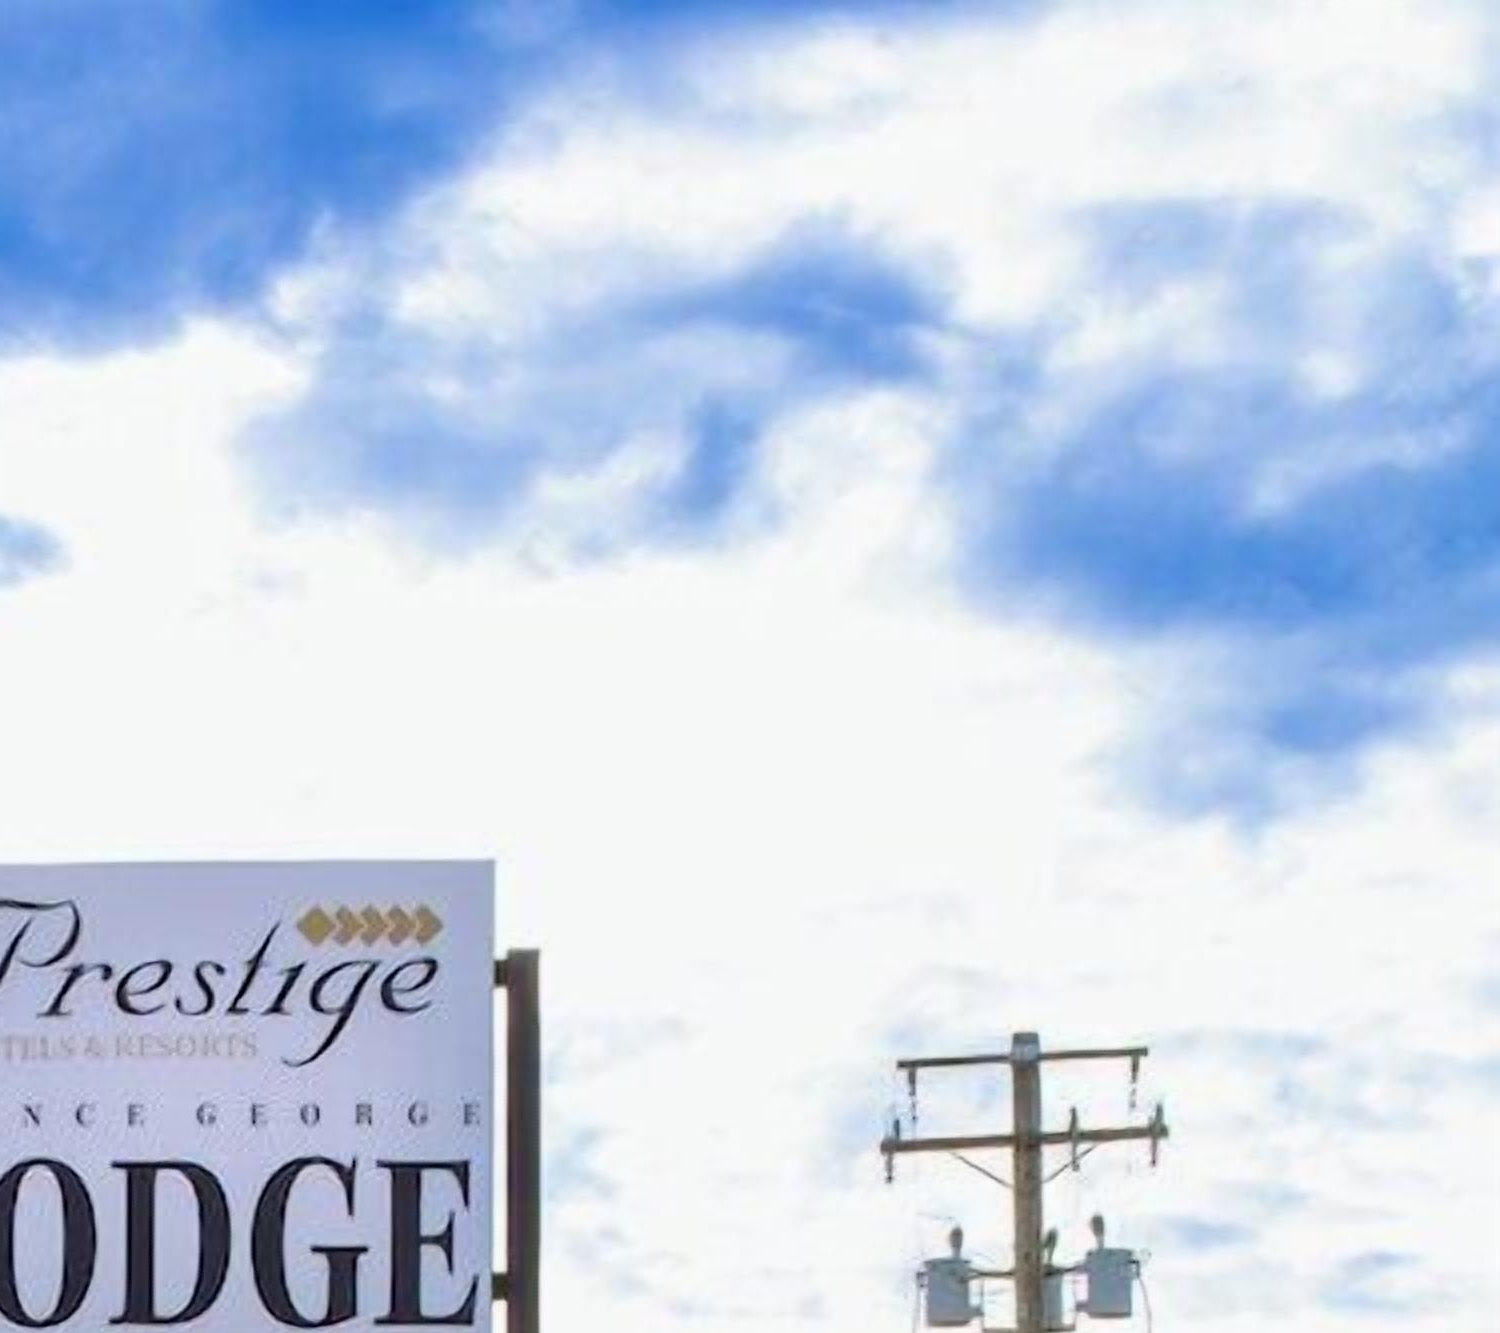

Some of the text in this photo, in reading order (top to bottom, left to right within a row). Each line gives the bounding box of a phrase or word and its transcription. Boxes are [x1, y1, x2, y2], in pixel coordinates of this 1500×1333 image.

[80, 1034, 101, 1059] &
[113, 1032, 258, 1060] RESORTS
[195, 1102, 483, 1128] GEORGE
